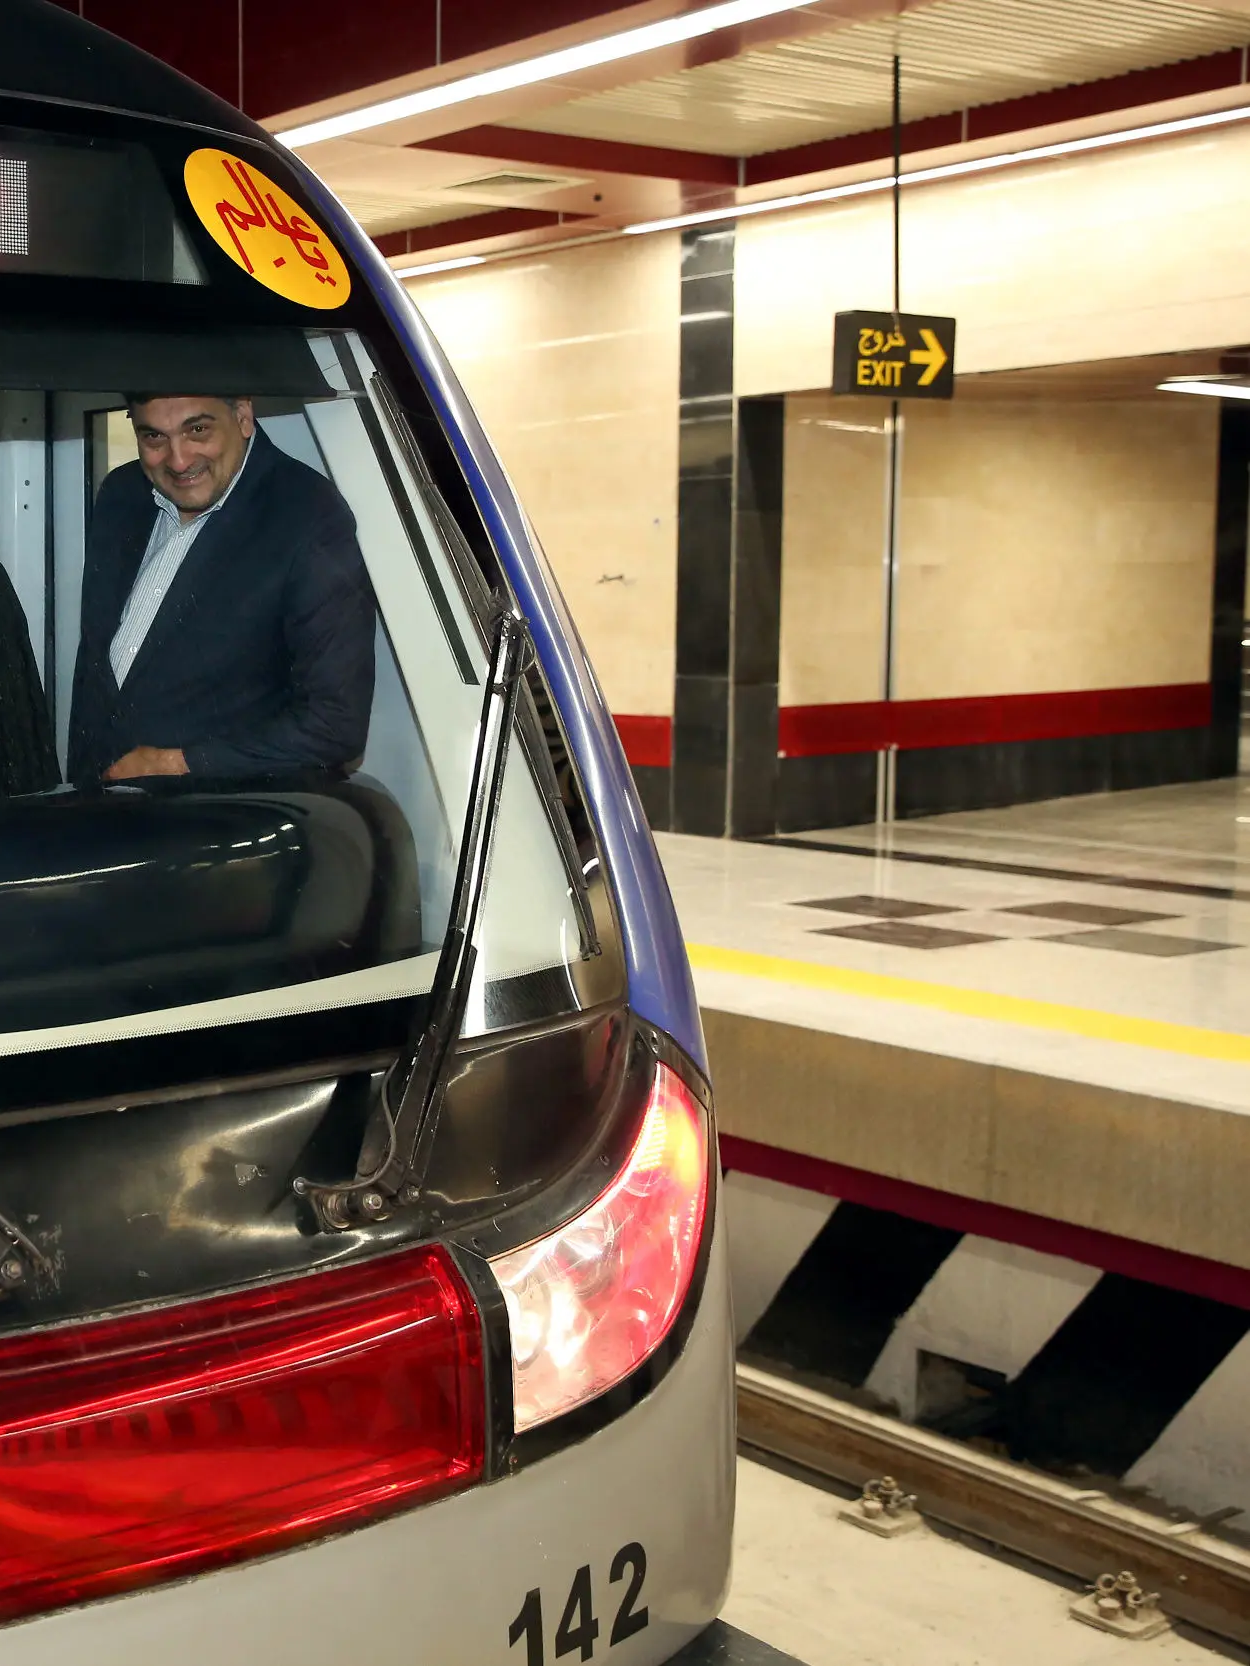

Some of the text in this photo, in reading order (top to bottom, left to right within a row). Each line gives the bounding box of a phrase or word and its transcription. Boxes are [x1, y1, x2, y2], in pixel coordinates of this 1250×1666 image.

[858, 327, 906, 356] خروج
[856, 358, 906, 387] EXIT
[508, 1541, 649, 1666] 142
